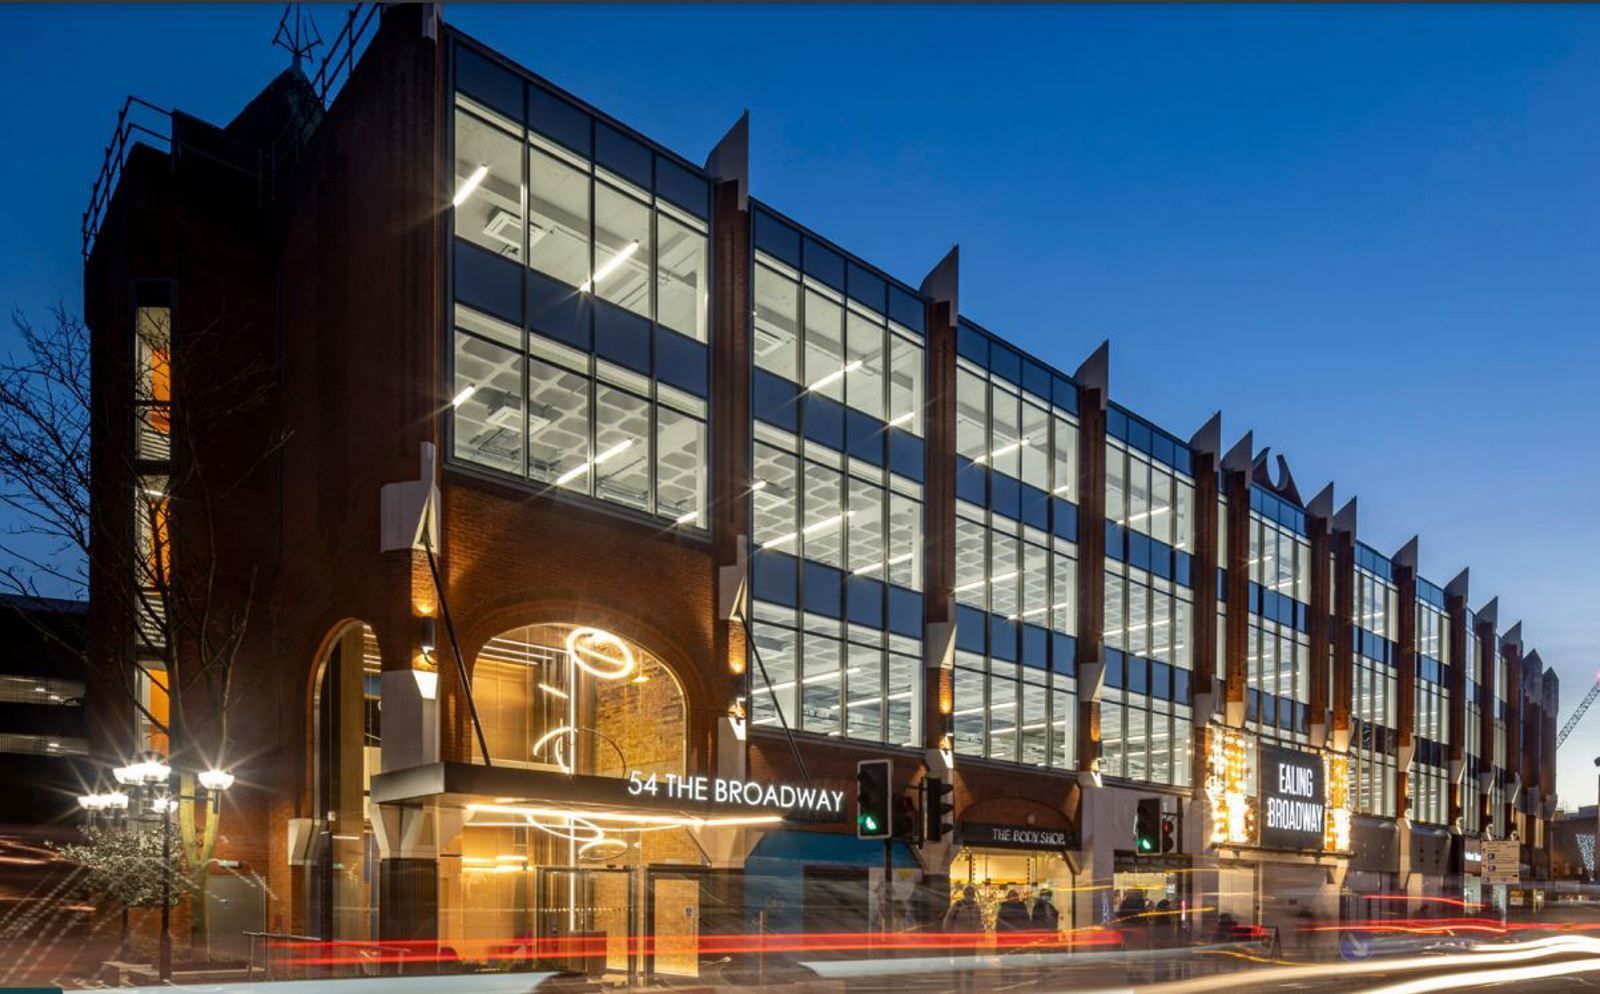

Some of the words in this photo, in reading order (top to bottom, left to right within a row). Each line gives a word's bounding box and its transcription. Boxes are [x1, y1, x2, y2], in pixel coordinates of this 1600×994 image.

[627, 770, 658, 797] 54
[664, 773, 708, 801] THE
[714, 778, 844, 812] BROADWAY
[1277, 762, 1314, 798] EALING
[1266, 797, 1324, 833] BROADWAY
[992, 828, 1011, 841] THE
[1012, 830, 1040, 843] BODY
